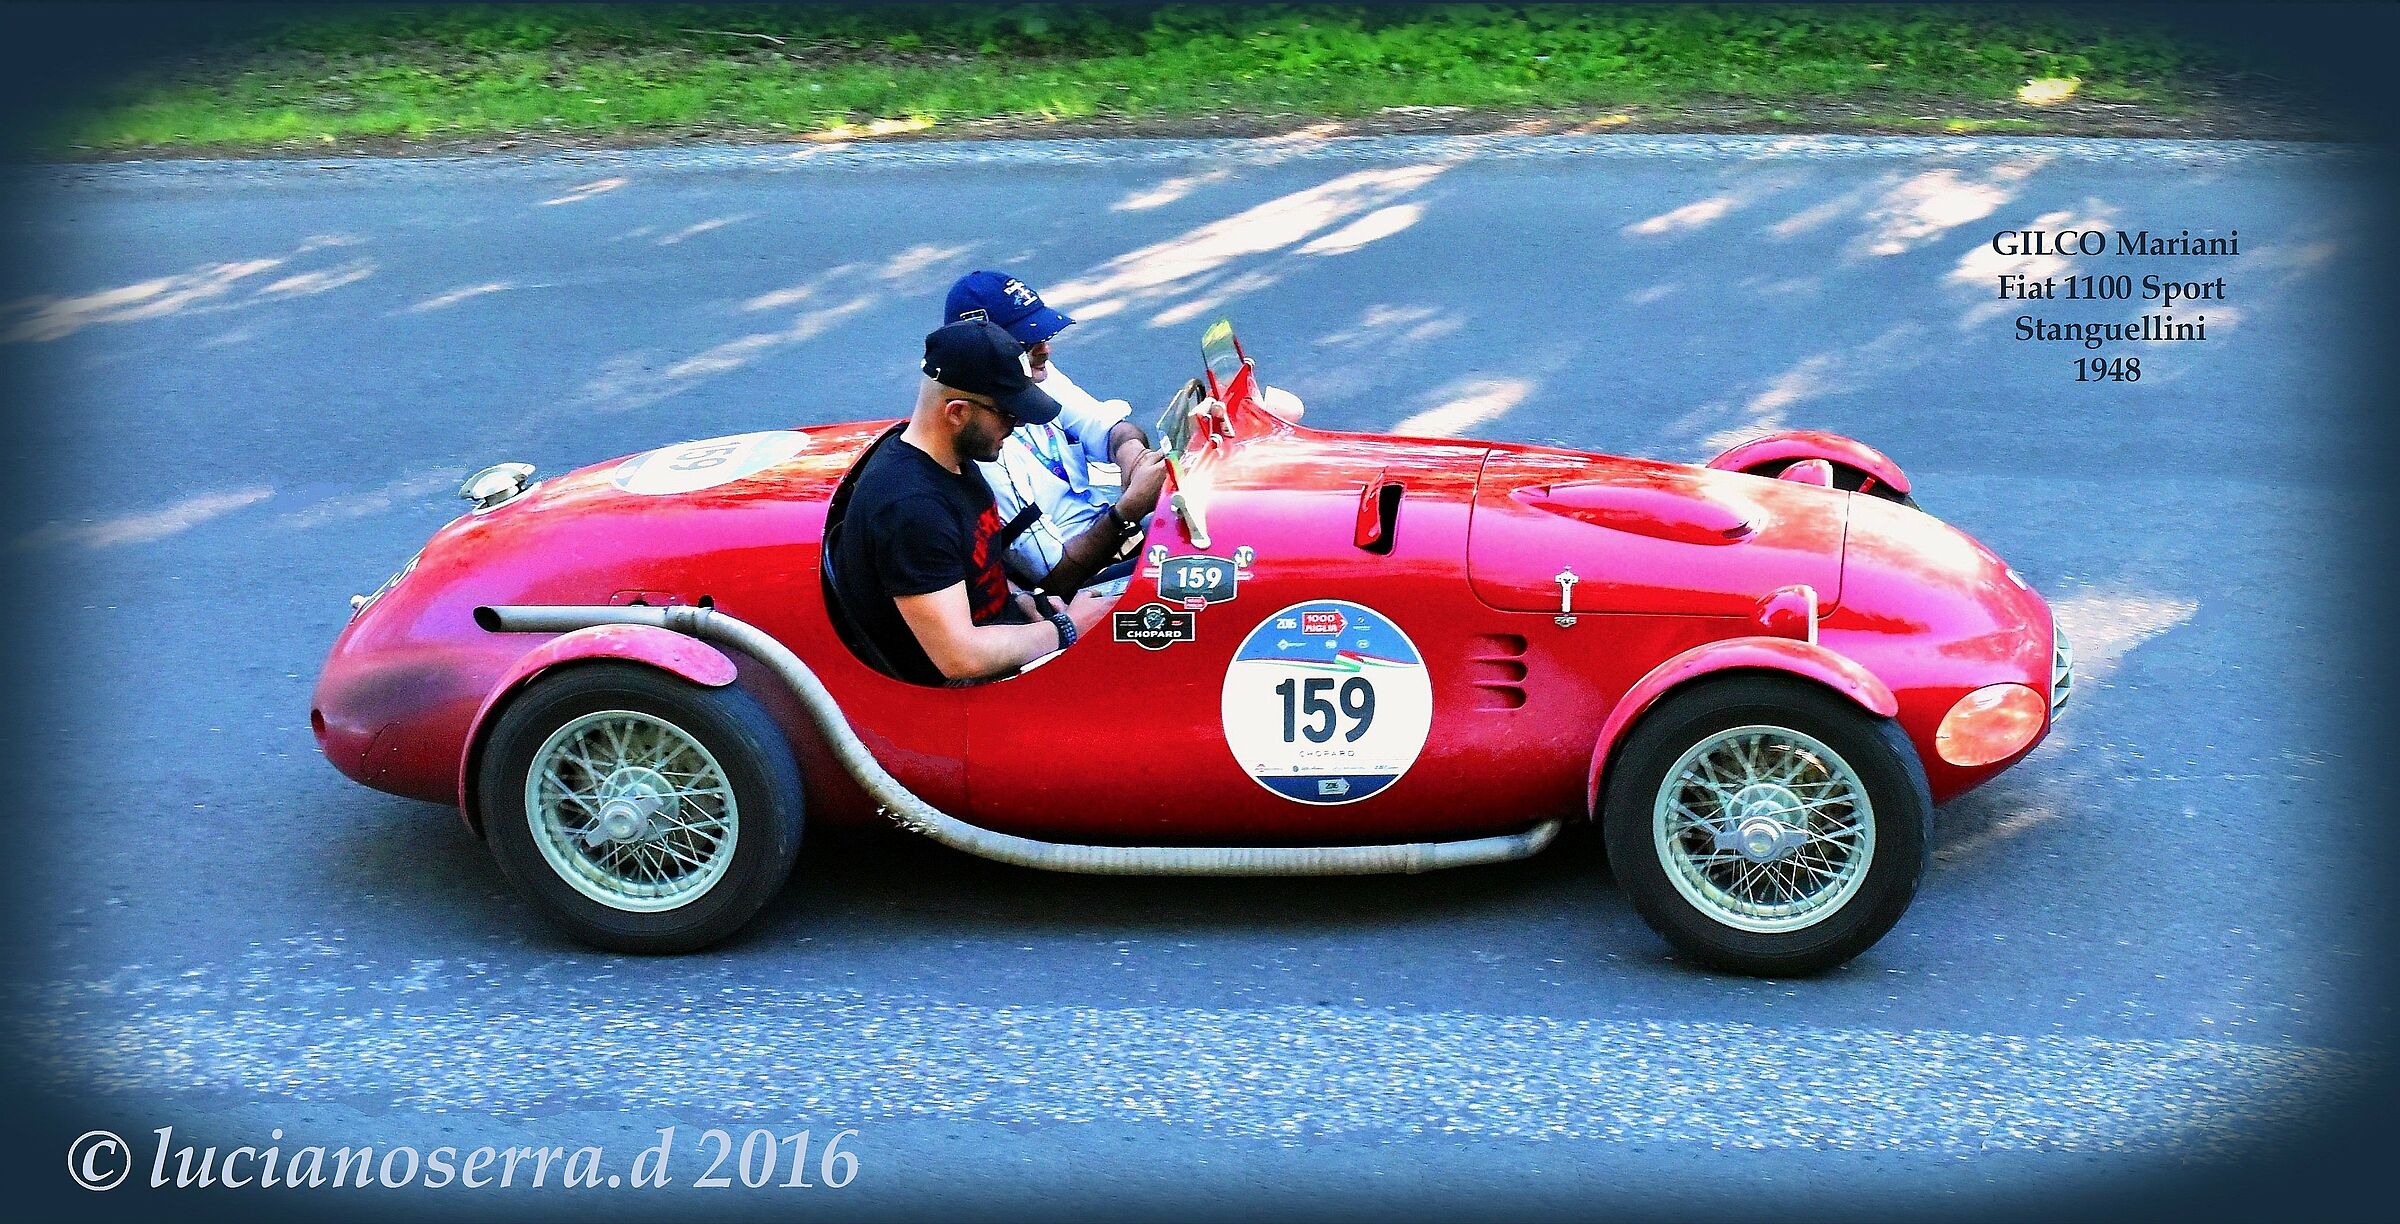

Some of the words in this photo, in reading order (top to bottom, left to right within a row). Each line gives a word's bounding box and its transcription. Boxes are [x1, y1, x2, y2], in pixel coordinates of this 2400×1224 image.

[669, 442, 741, 471] 159
[1177, 567, 1222, 589] 159
[1305, 614, 1336, 623] 1000
[1126, 630, 1182, 638] CHOPARD
[1304, 624, 1338, 633] MIGLIA
[1275, 676, 1376, 743] 159
